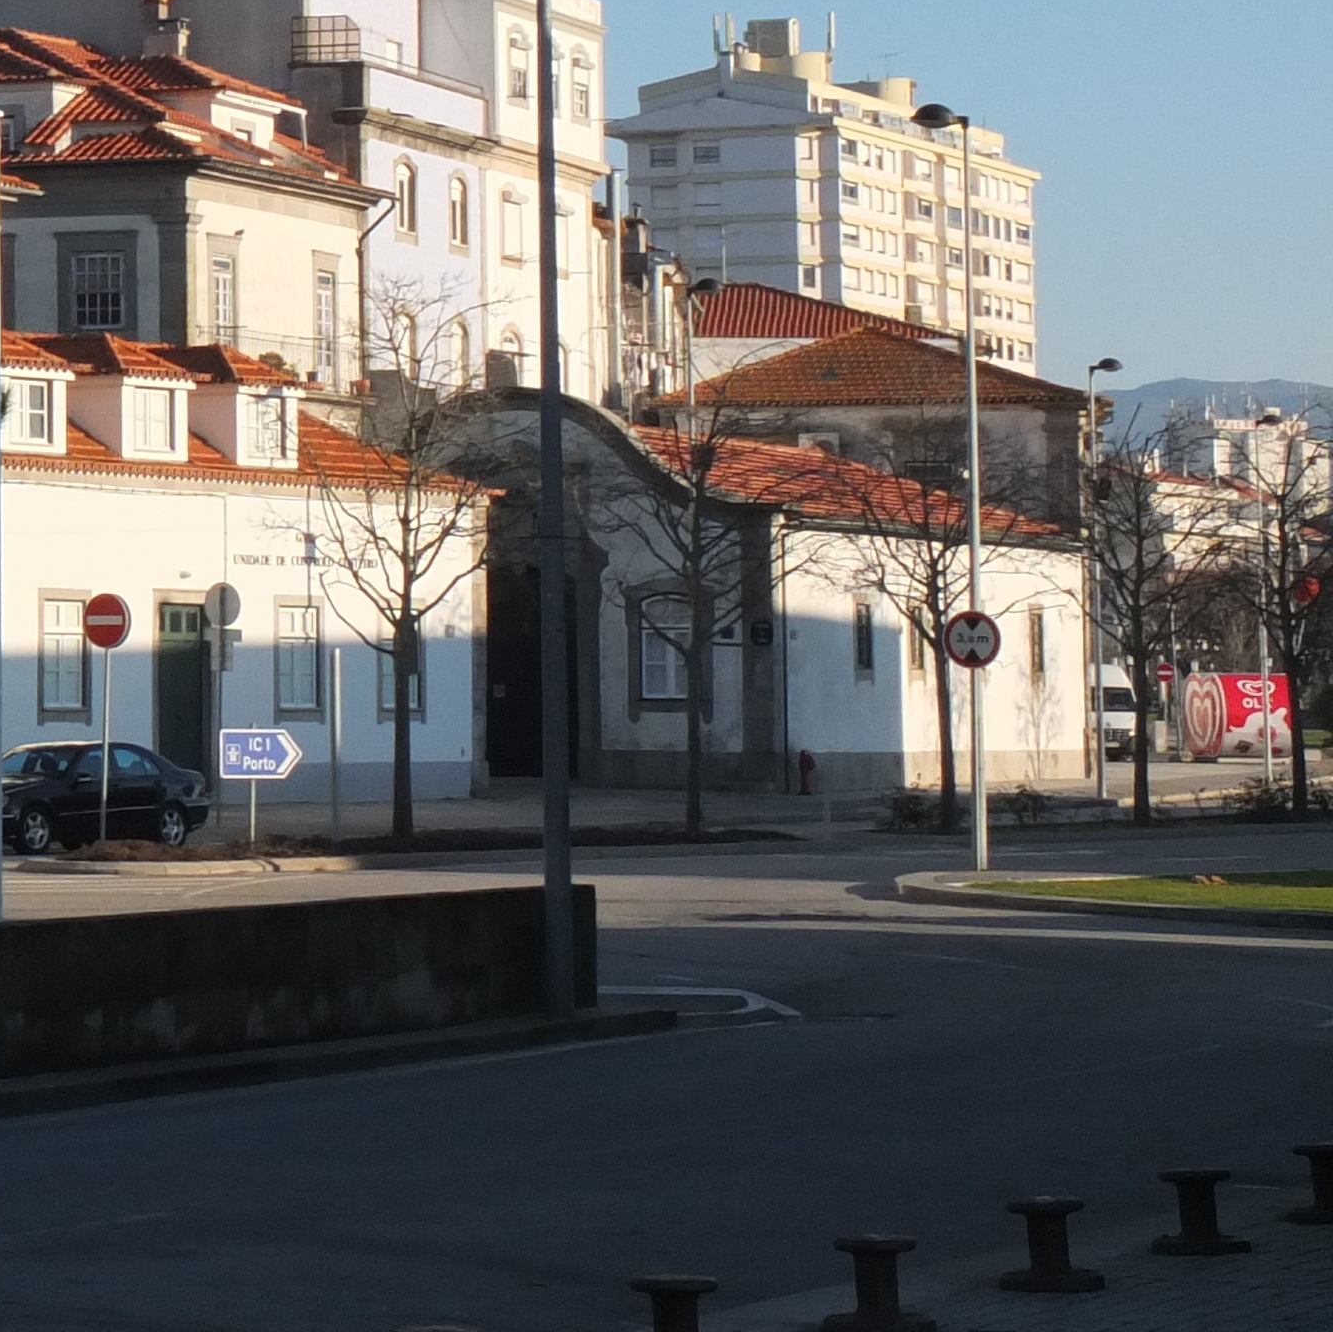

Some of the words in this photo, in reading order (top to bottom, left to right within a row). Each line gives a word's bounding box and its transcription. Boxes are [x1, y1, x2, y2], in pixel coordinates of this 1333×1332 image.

[276, 555, 287, 566] DE
[291, 556, 335, 567] CONROLO
[1242, 697, 1273, 709] OL
[248, 737, 263, 752] IC
[243, 755, 276, 771] Porto
